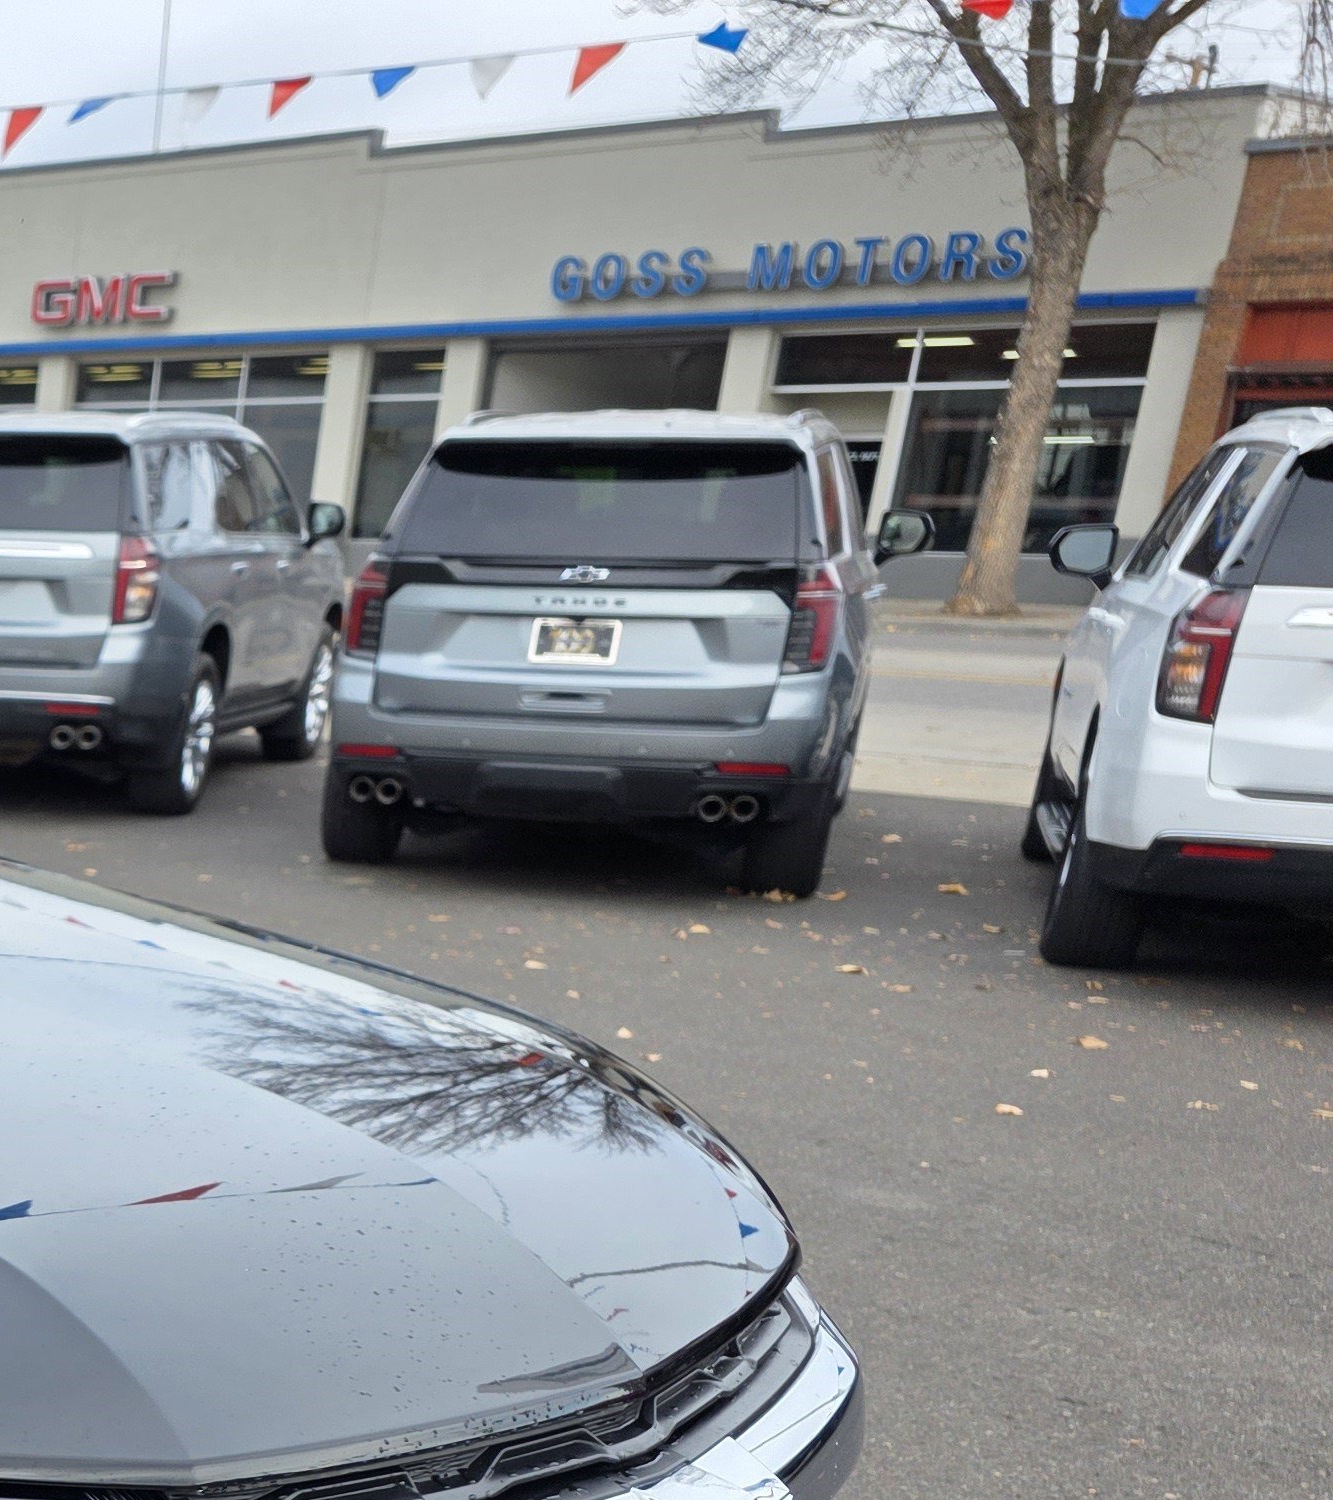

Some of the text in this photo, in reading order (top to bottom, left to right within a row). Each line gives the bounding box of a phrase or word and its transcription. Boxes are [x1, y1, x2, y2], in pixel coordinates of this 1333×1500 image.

[550, 226, 1031, 303] GOSS MOTORS
[30, 271, 174, 327] GMC
